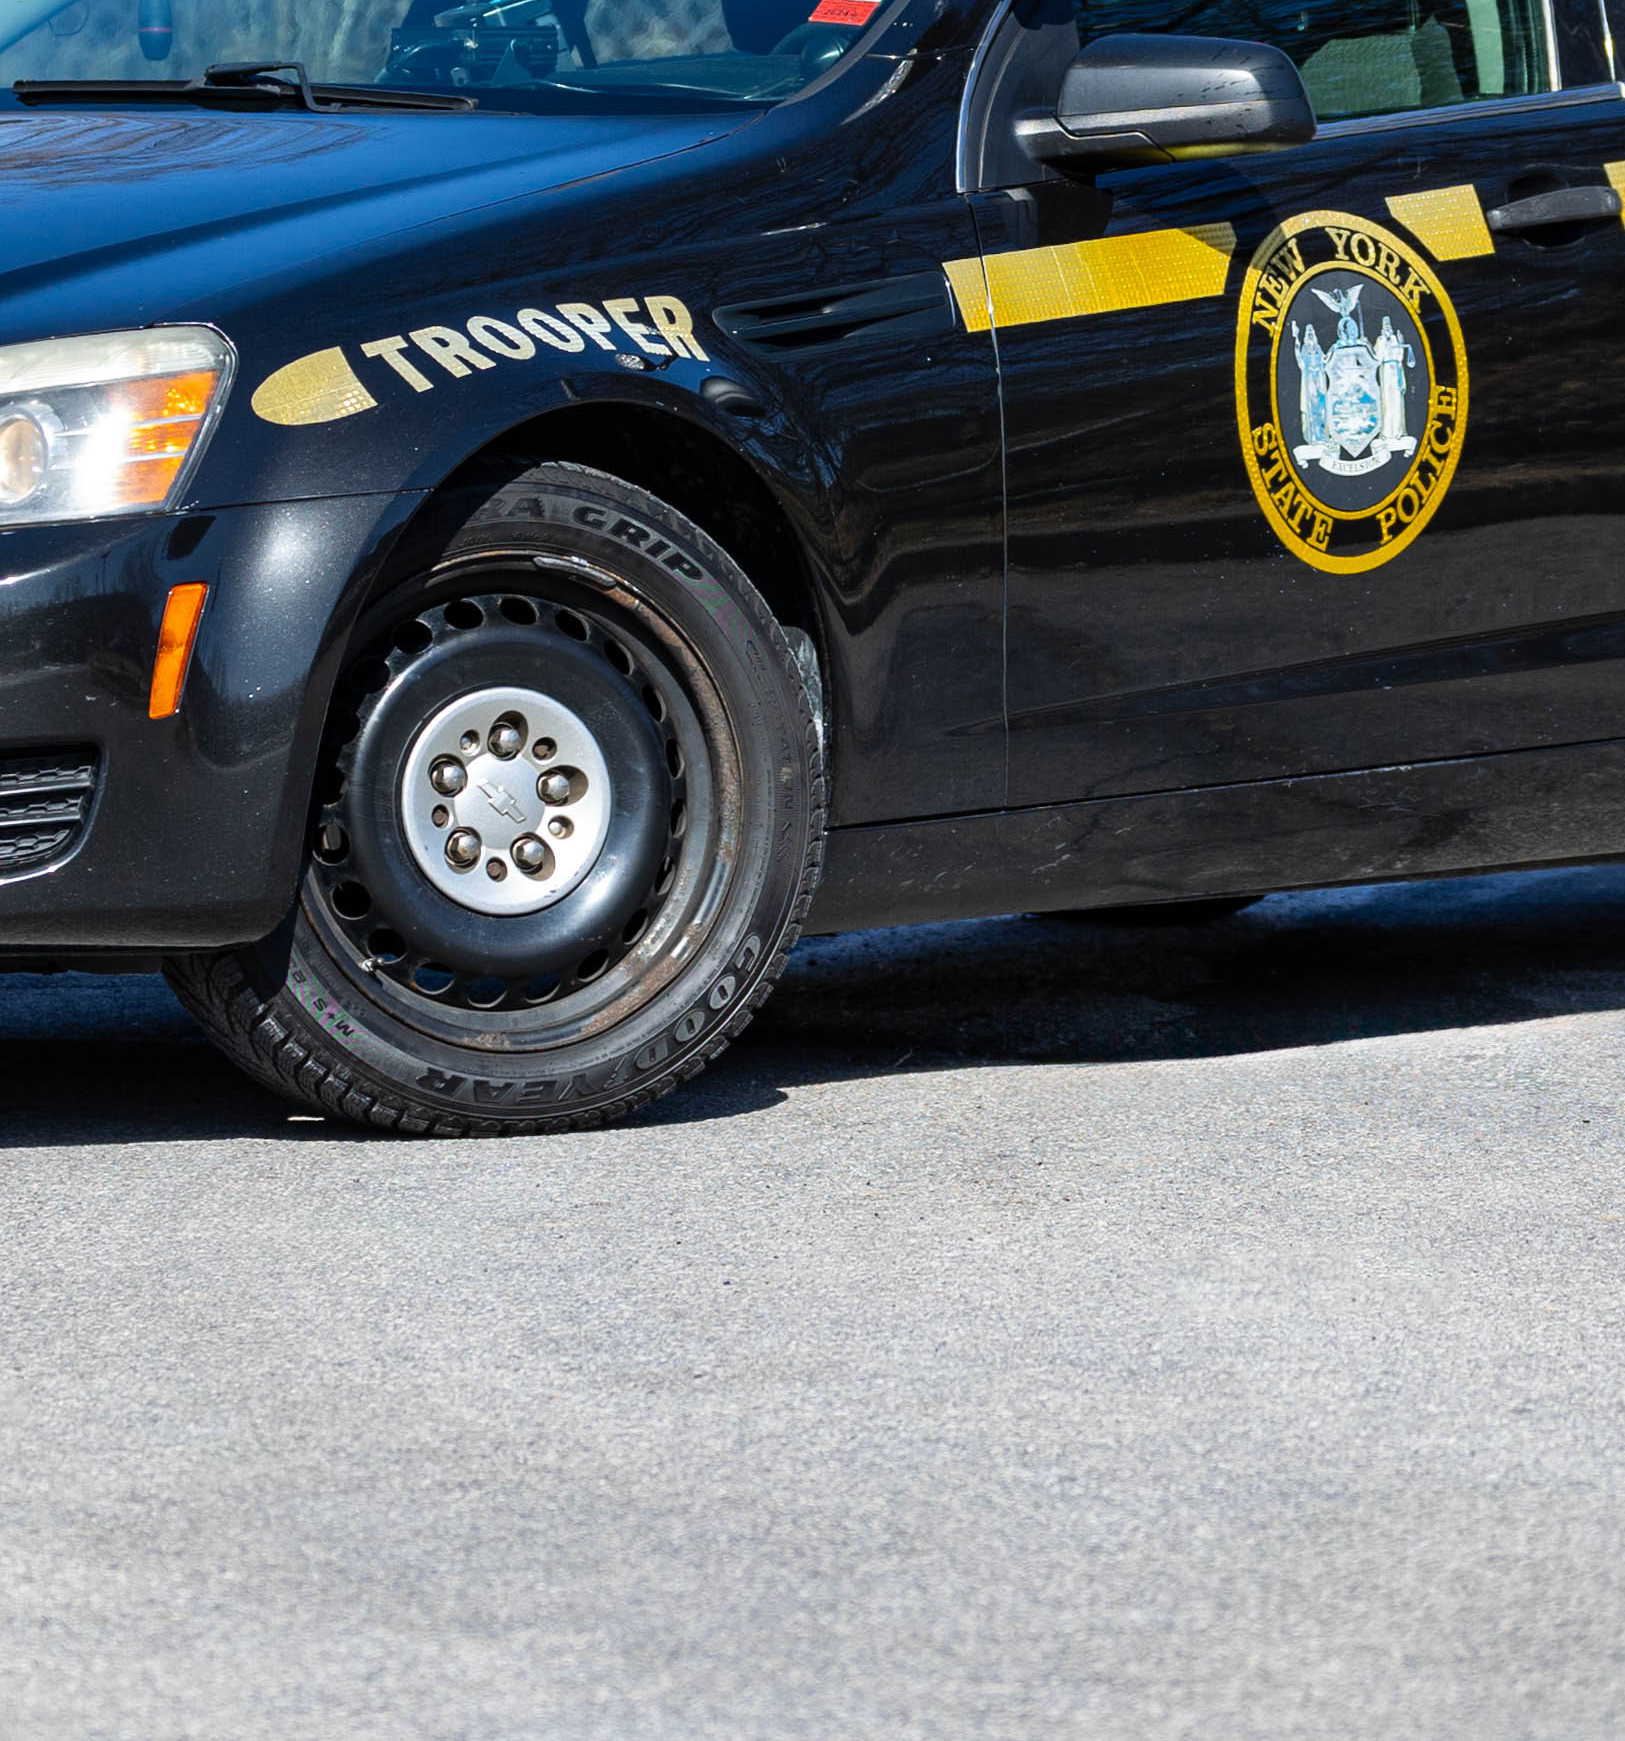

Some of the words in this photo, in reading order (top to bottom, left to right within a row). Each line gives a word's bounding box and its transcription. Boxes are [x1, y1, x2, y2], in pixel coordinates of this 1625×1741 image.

[1252, 237, 1308, 338] NEW
[1325, 227, 1432, 314] YORK
[360, 295, 711, 393] TROOPER
[1251, 422, 1334, 553] STATE
[1375, 385, 1458, 546] POLICE
[572, 506, 705, 581] GRIP
[417, 933, 763, 1106] GOODYEAR
